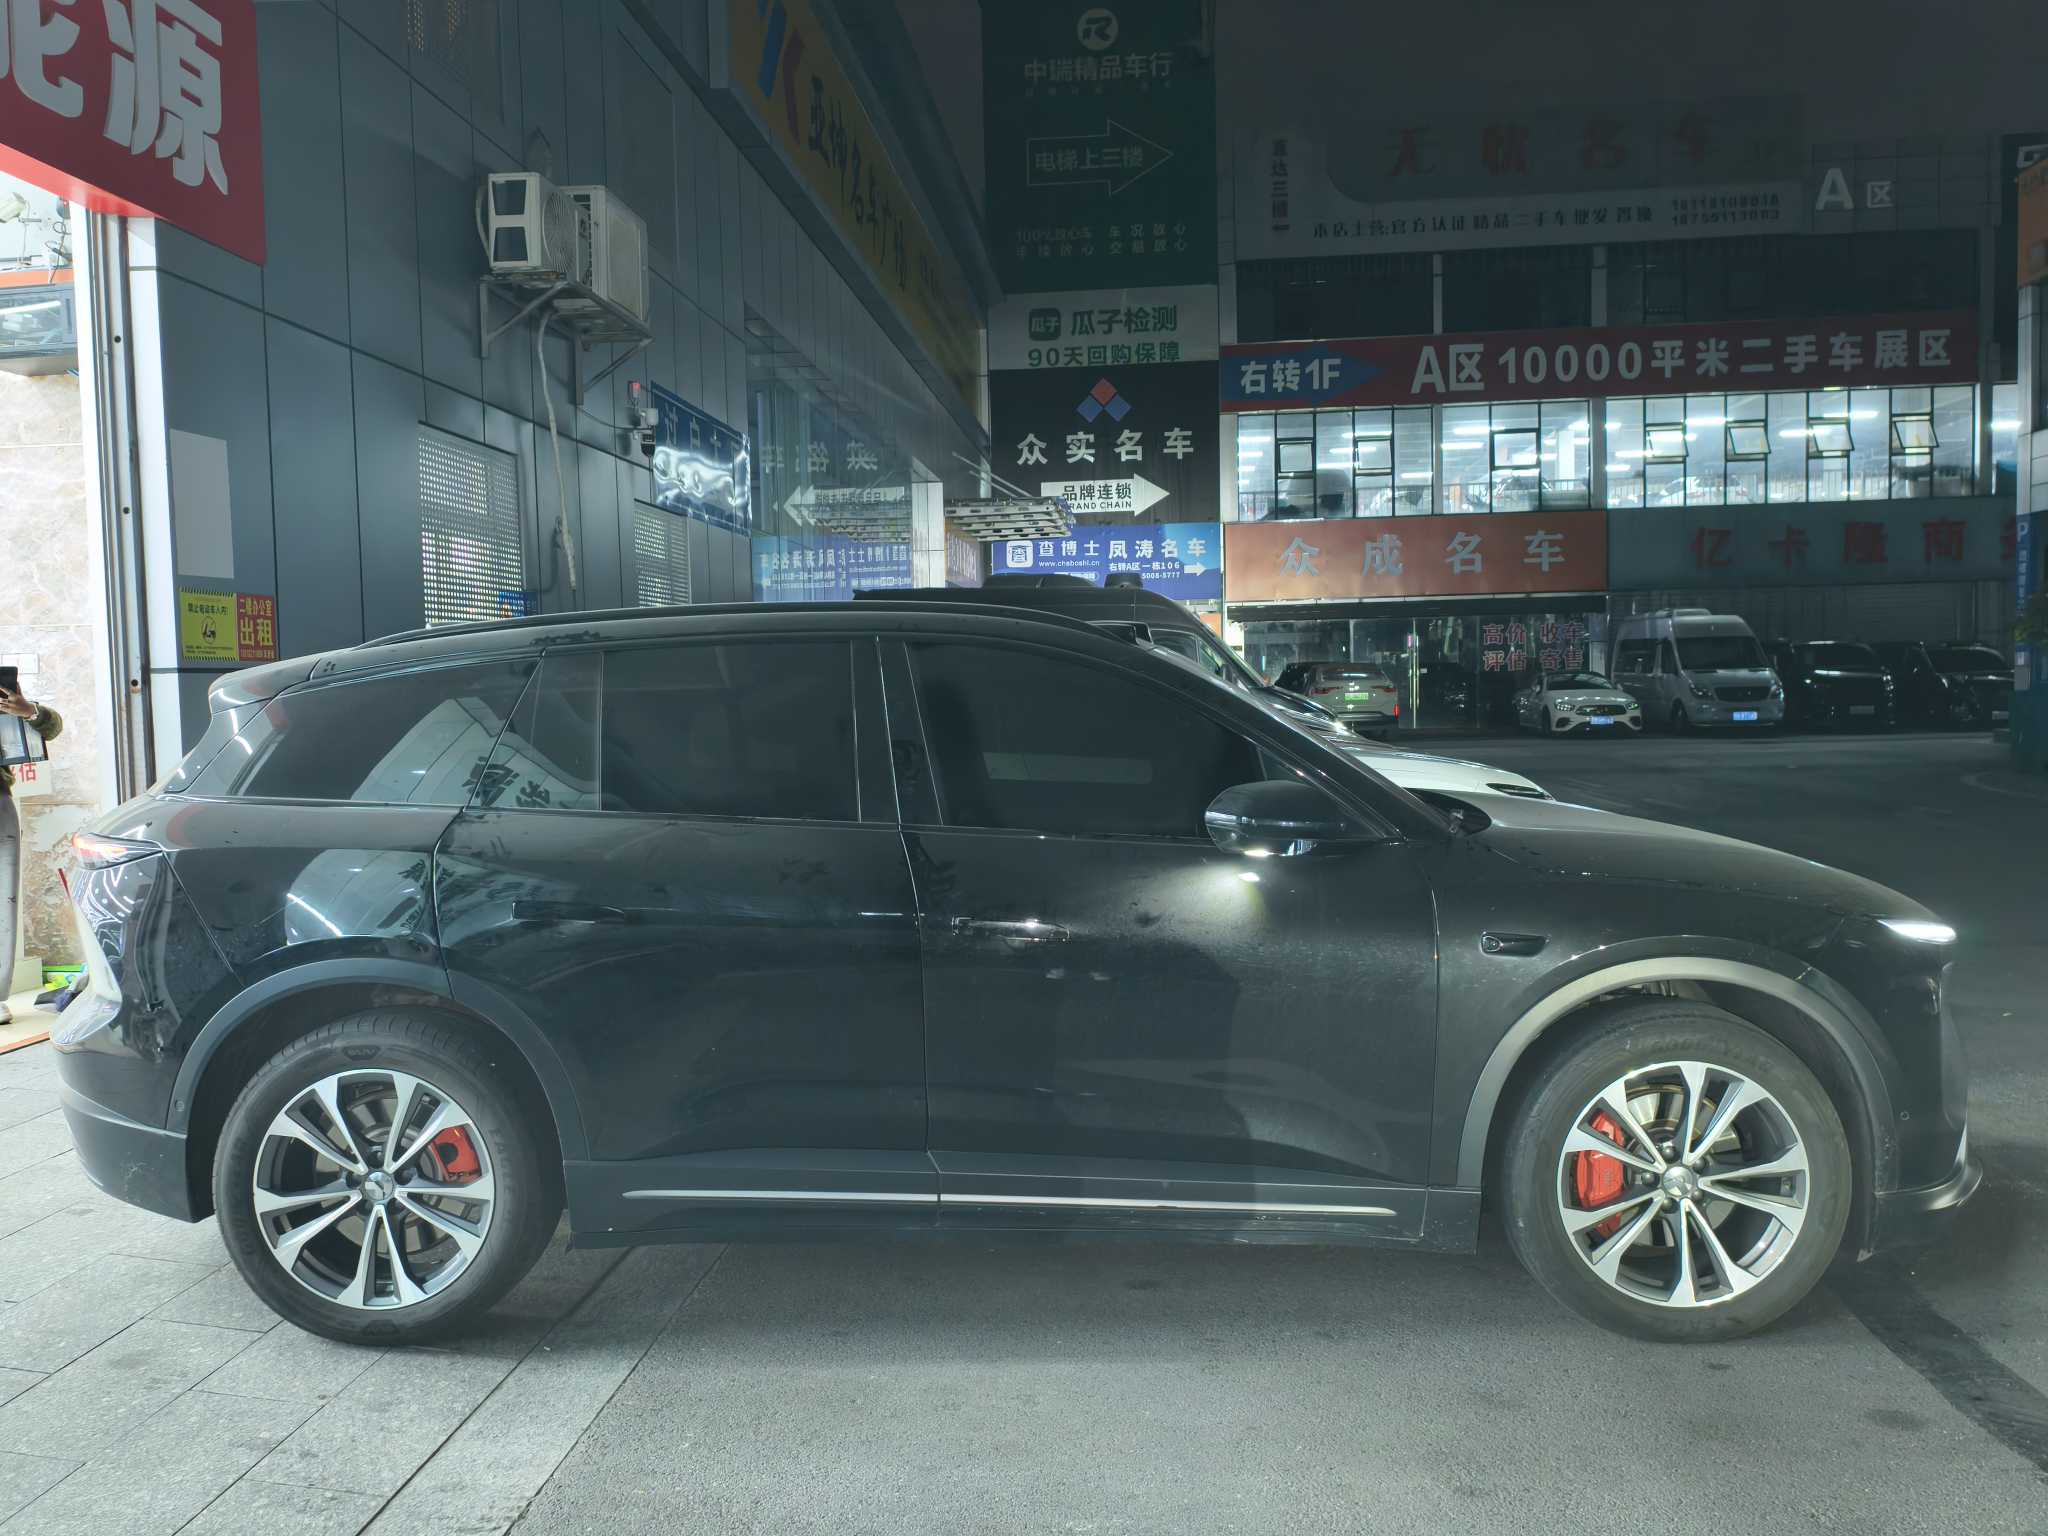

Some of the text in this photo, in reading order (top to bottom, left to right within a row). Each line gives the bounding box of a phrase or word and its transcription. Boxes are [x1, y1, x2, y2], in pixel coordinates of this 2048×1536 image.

[1023, 52, 1175, 86] 中瑞精品车行
[1034, 145, 1143, 172] 电梯上三楼
[1816, 167, 1894, 211] A区
[1071, 305, 1178, 337] 瓜子检测
[1028, 341, 1182, 368] 90天回购保障
[1240, 357, 1342, 393] 右转1F
[1016, 427, 1195, 467] 众实名车
[1062, 482, 1132, 501] 品牌连锁
[1099, 500, 1132, 510] CHAIN
[1038, 540, 1101, 557] 查博士
[1109, 537, 1207, 559] 凤涛名车
[1278, 529, 1567, 578] 众成名车
[240, 617, 274, 648] 出租
[1482, 622, 1527, 646] 高价
[1482, 650, 1527, 672] 评估
